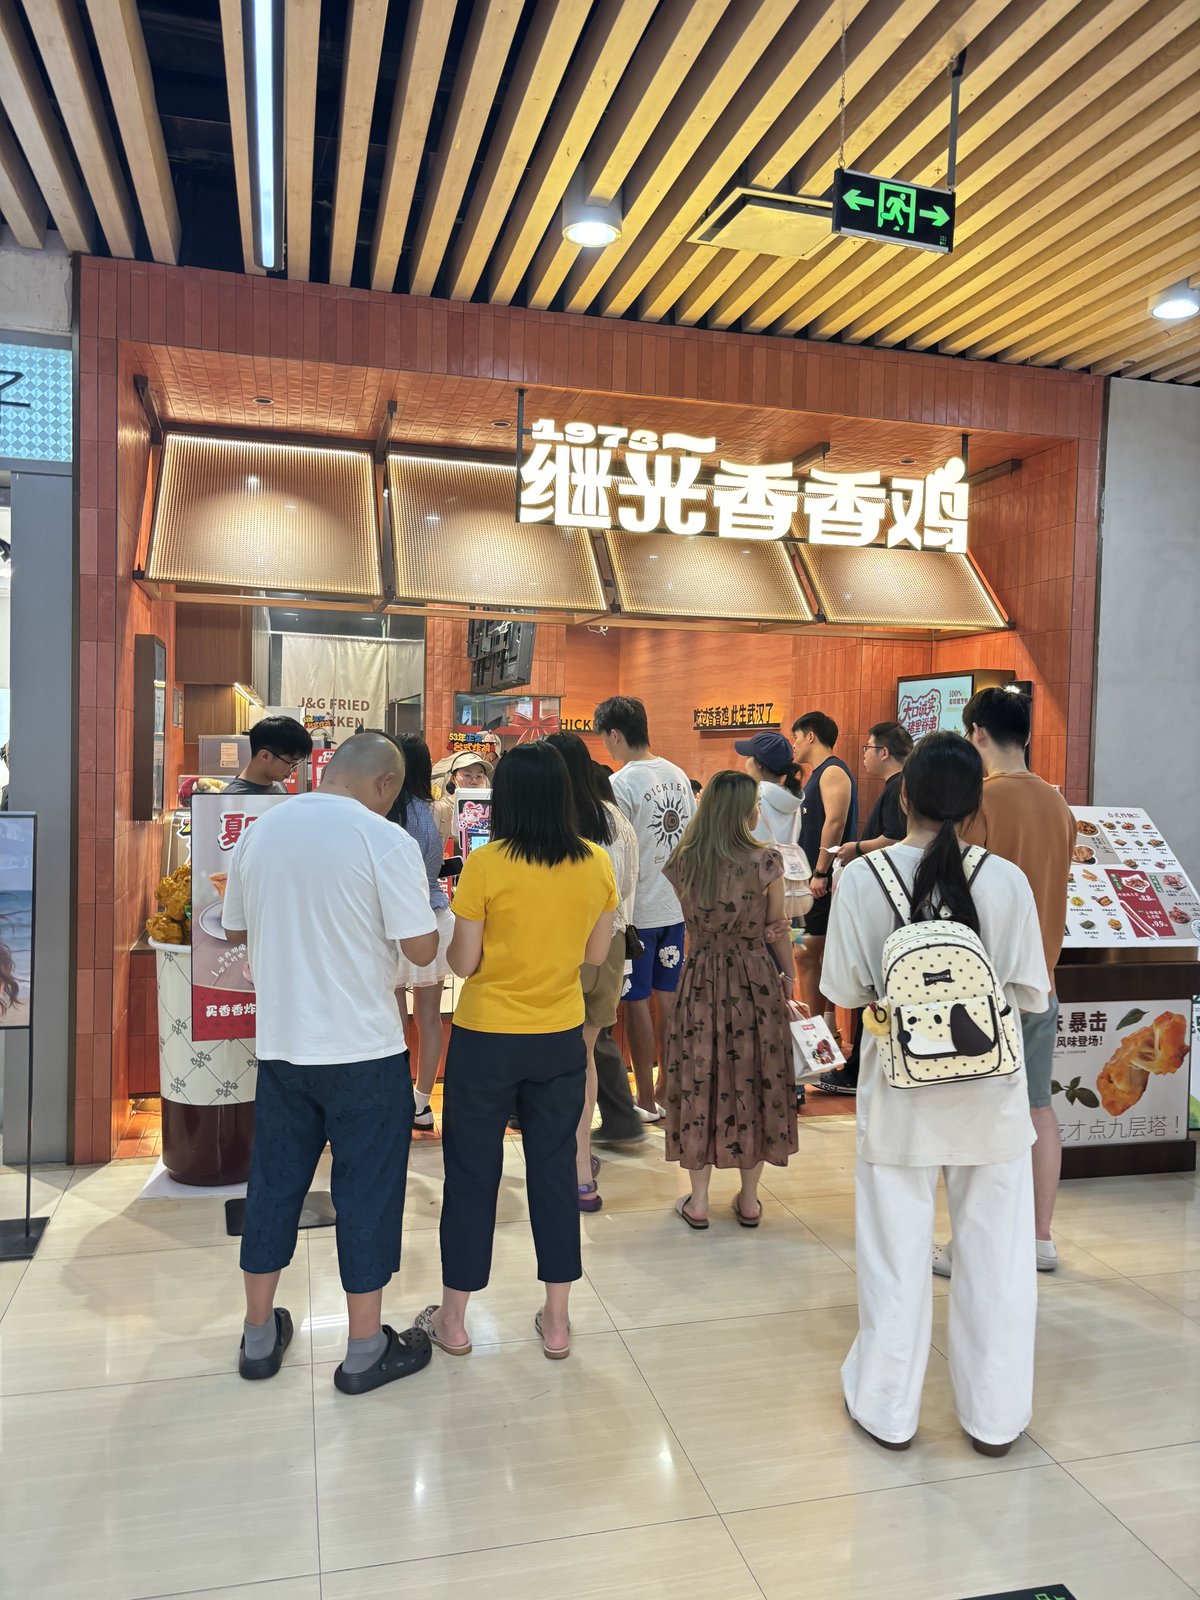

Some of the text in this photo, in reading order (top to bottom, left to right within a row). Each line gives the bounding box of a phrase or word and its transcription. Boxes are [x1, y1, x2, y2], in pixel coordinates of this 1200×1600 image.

[519, 443, 969, 554] 继光香香鸡
[298, 697, 370, 711] J&G FRIED
[643, 782, 687, 802] DICKIES
